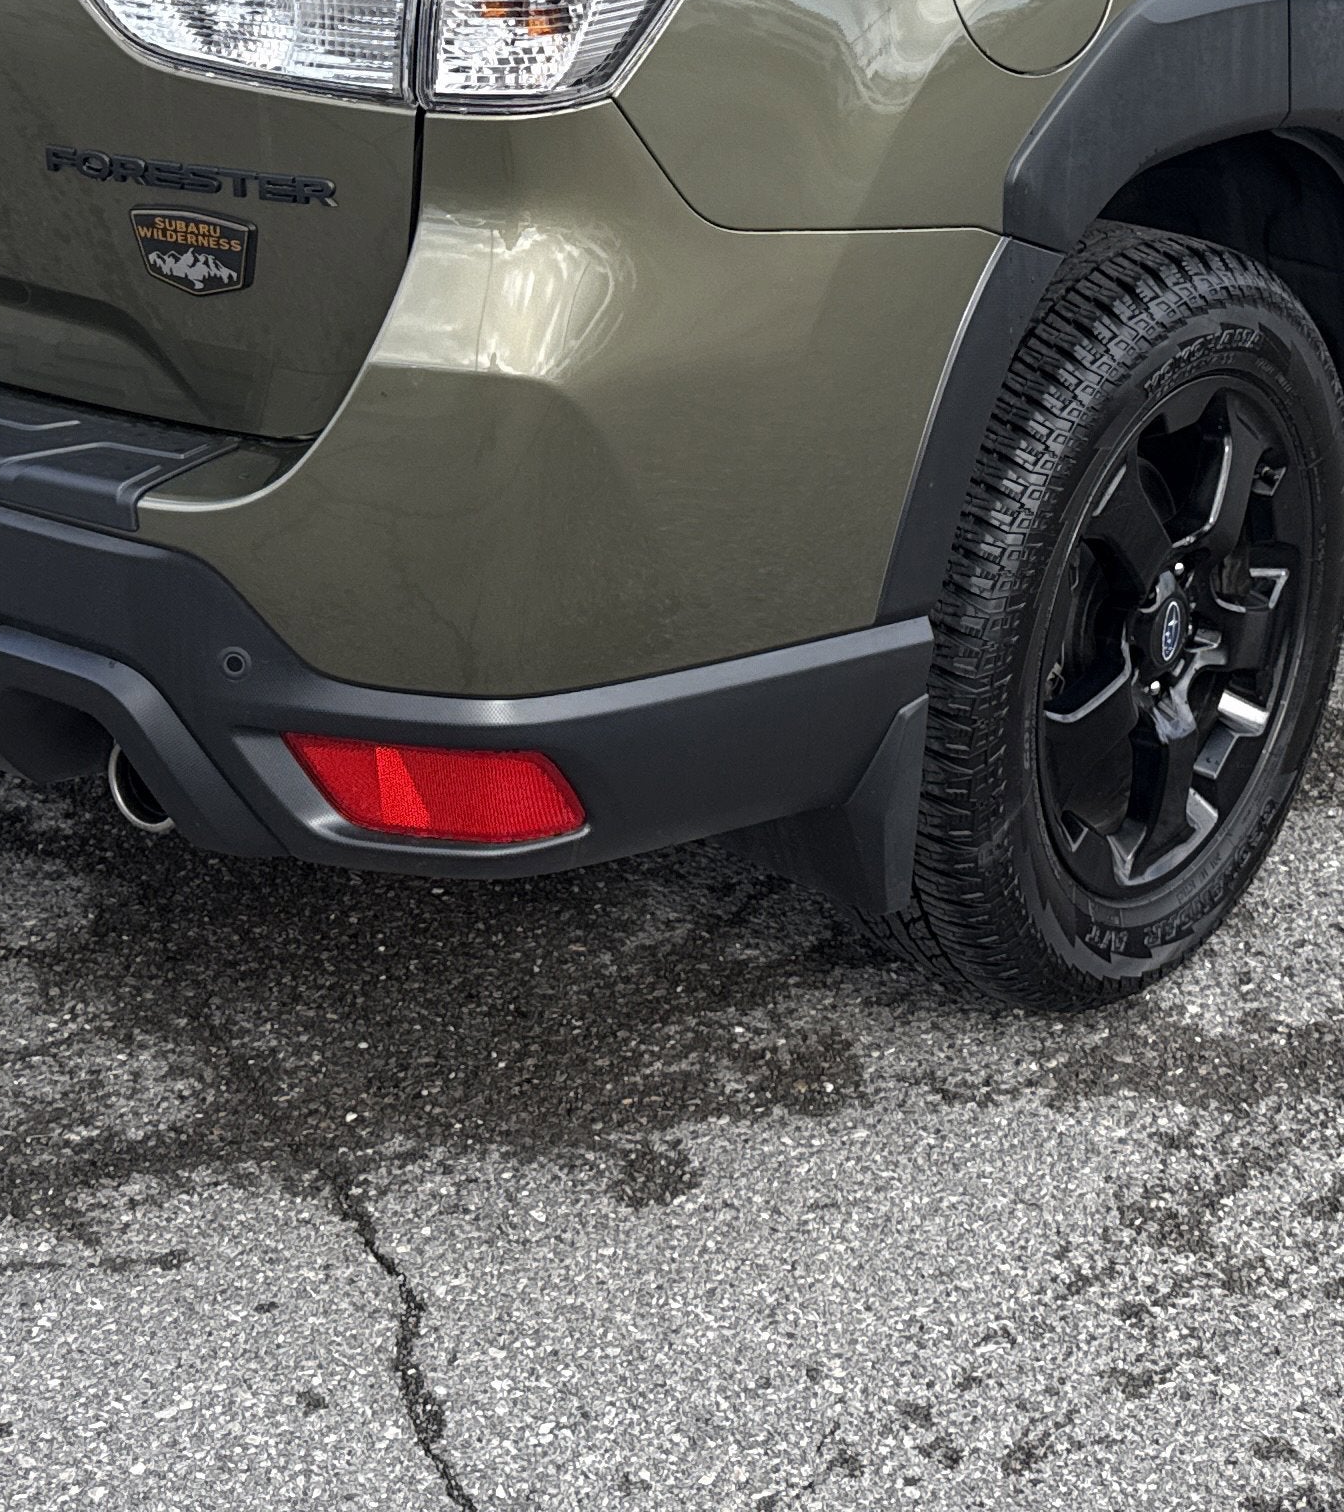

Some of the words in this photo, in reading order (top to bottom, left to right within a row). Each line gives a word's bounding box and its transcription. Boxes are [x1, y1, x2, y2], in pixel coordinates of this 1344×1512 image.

[44, 143, 341, 208] FORESTER
[137, 225, 242, 252] WILDERNESS
[154, 216, 221, 237] SUBARU
